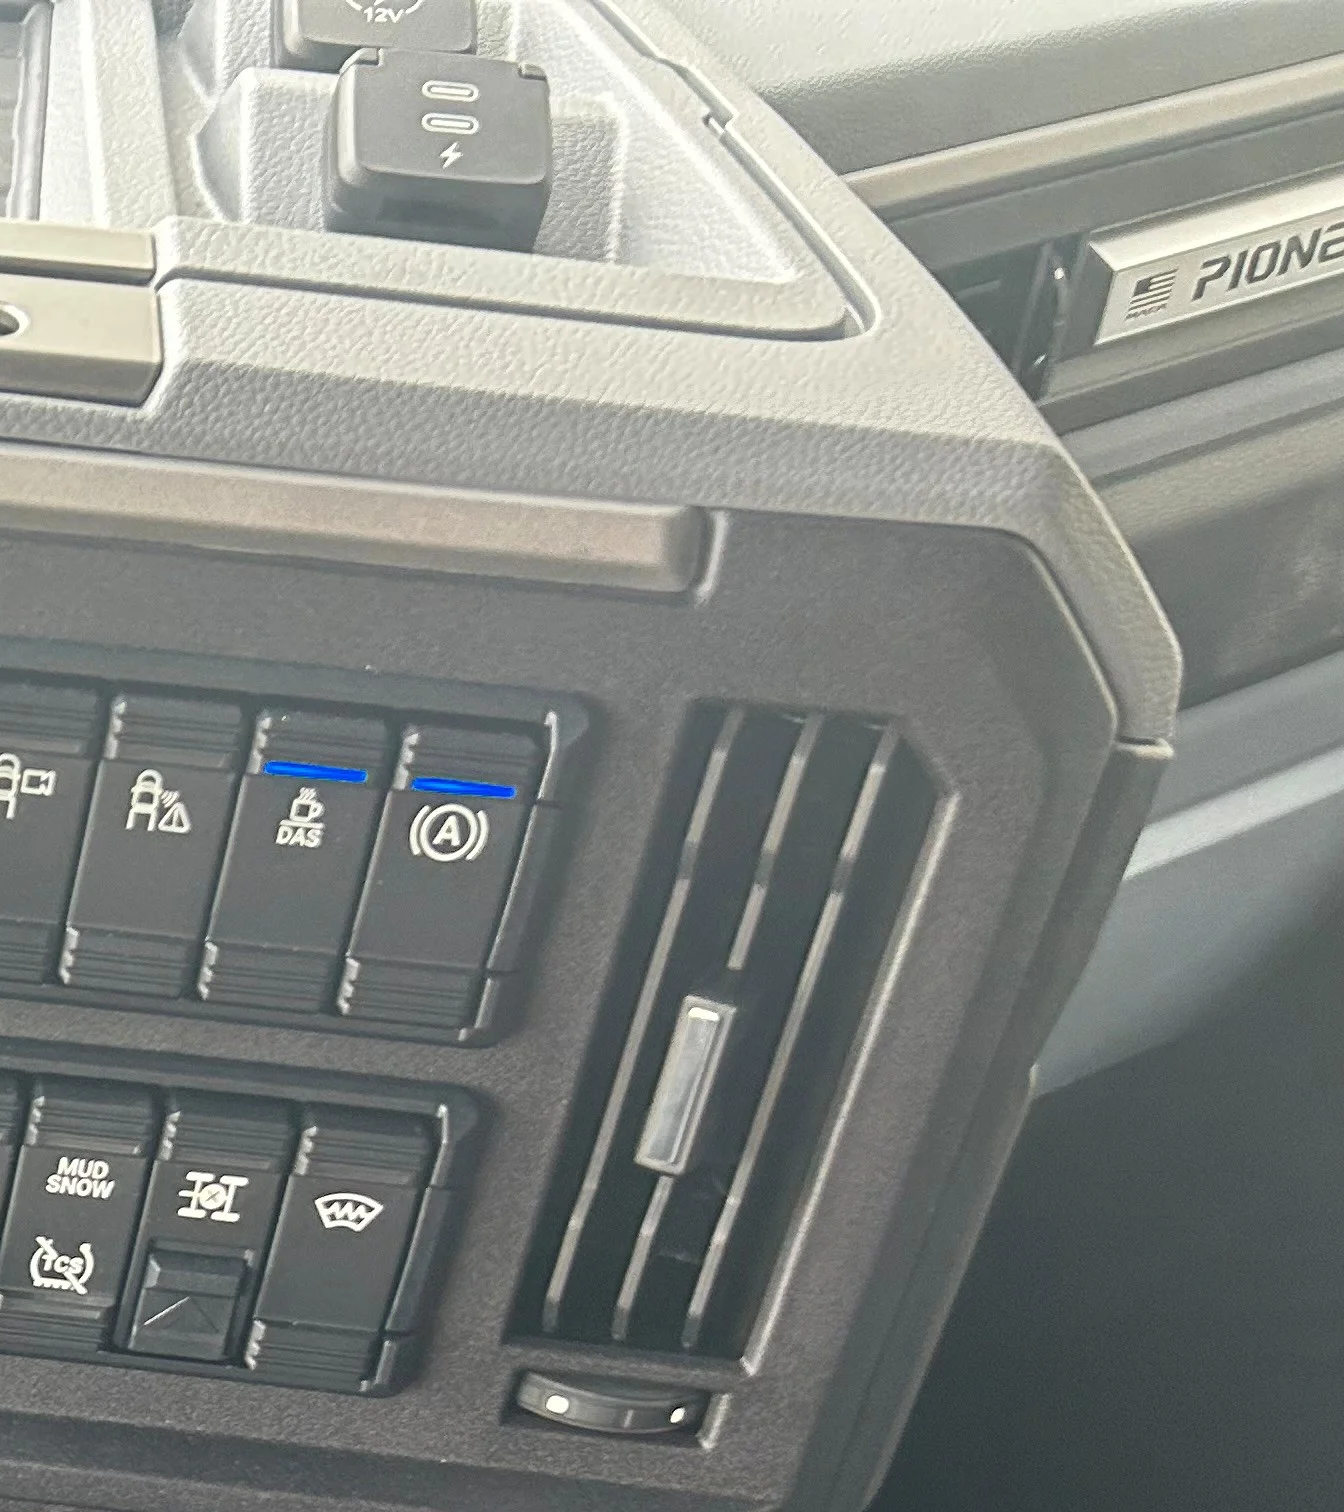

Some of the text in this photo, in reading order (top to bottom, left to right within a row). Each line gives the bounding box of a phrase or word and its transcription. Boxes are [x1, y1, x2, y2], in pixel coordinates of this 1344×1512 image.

[364, 7, 401, 23] 12V
[276, 824, 324, 847] DAS
[431, 815, 460, 846] A
[57, 1157, 109, 1180] MUD
[46, 1173, 115, 1198] SNOW
[42, 1253, 85, 1274] TCS
